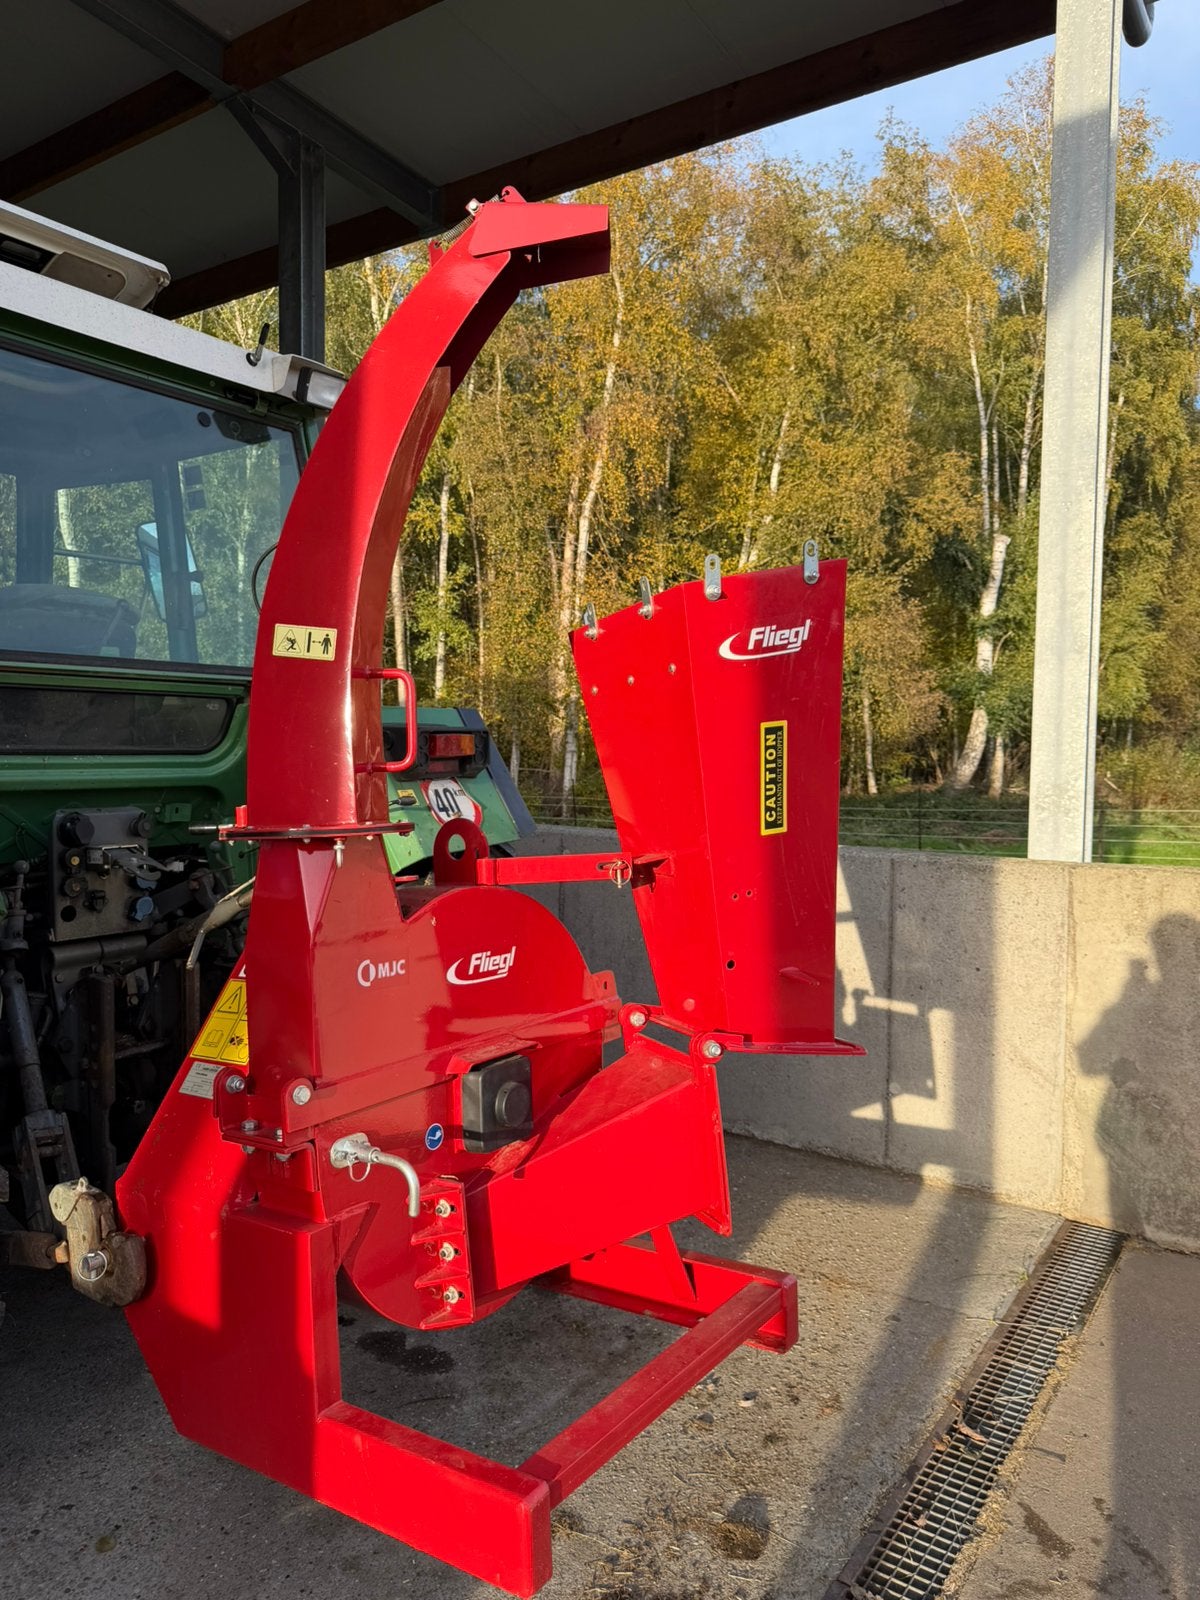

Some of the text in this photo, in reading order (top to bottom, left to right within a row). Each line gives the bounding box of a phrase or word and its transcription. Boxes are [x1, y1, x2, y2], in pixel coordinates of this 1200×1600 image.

[748, 619, 811, 650] Fliegl
[766, 733, 777, 822] CAUTION
[433, 787, 462, 818] 40
[378, 959, 406, 979] MJC
[468, 946, 517, 975] Fliegl
